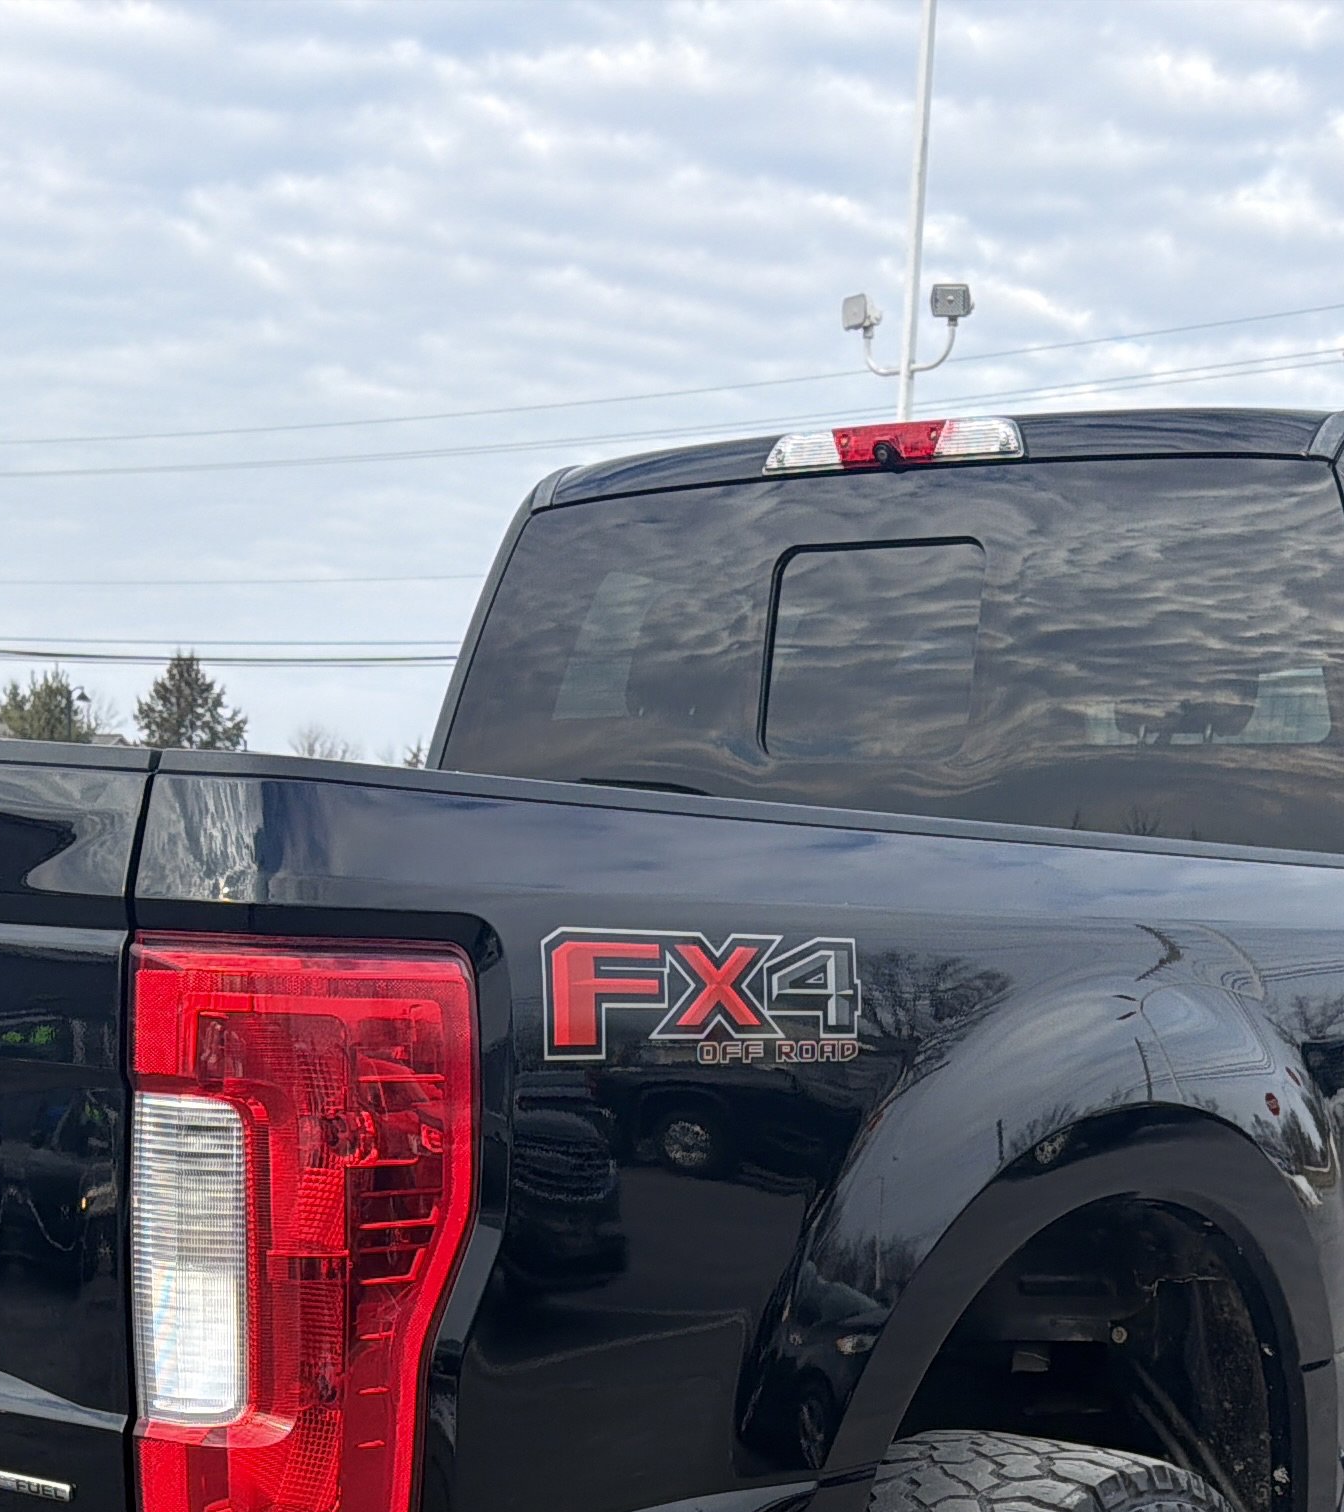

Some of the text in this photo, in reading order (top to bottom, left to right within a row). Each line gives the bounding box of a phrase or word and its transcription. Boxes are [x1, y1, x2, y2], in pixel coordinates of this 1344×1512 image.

[540, 926, 861, 1062] FX4
[697, 1040, 860, 1064] OFF ROAD
[15, 1479, 66, 1500] FUEL
